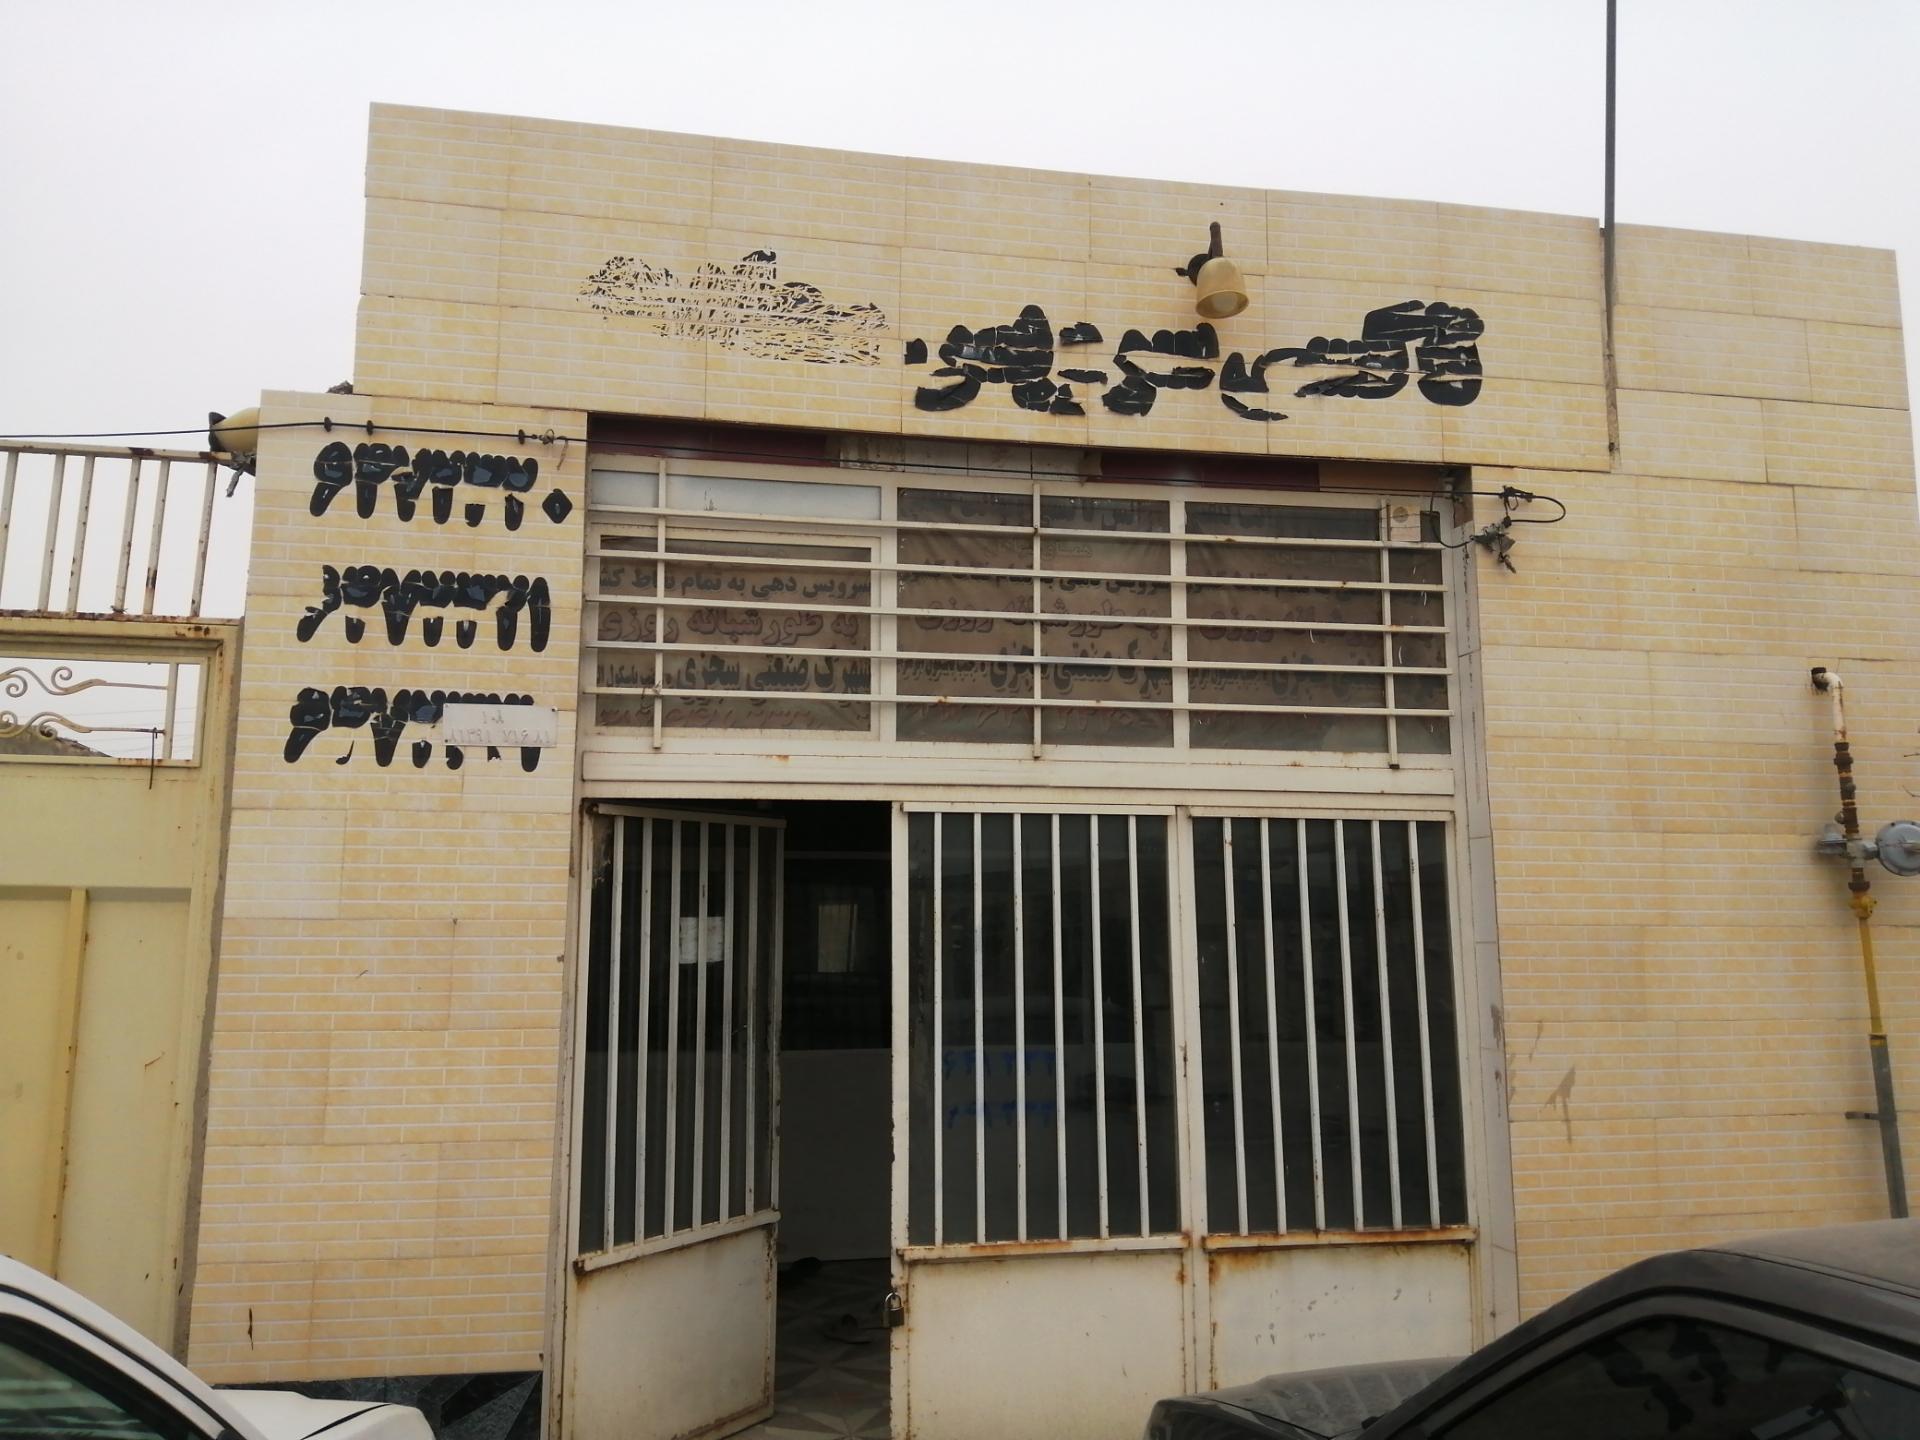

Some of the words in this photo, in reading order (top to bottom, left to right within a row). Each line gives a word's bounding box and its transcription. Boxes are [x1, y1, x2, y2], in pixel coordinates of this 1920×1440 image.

[681, 571, 722, 597] تمام
[727, 574, 746, 597] به
[752, 574, 797, 599] دهی
[598, 607, 679, 643] روزی
[687, 607, 762, 644] شبانه
[762, 609, 824, 647] طور
[831, 614, 860, 645] به
